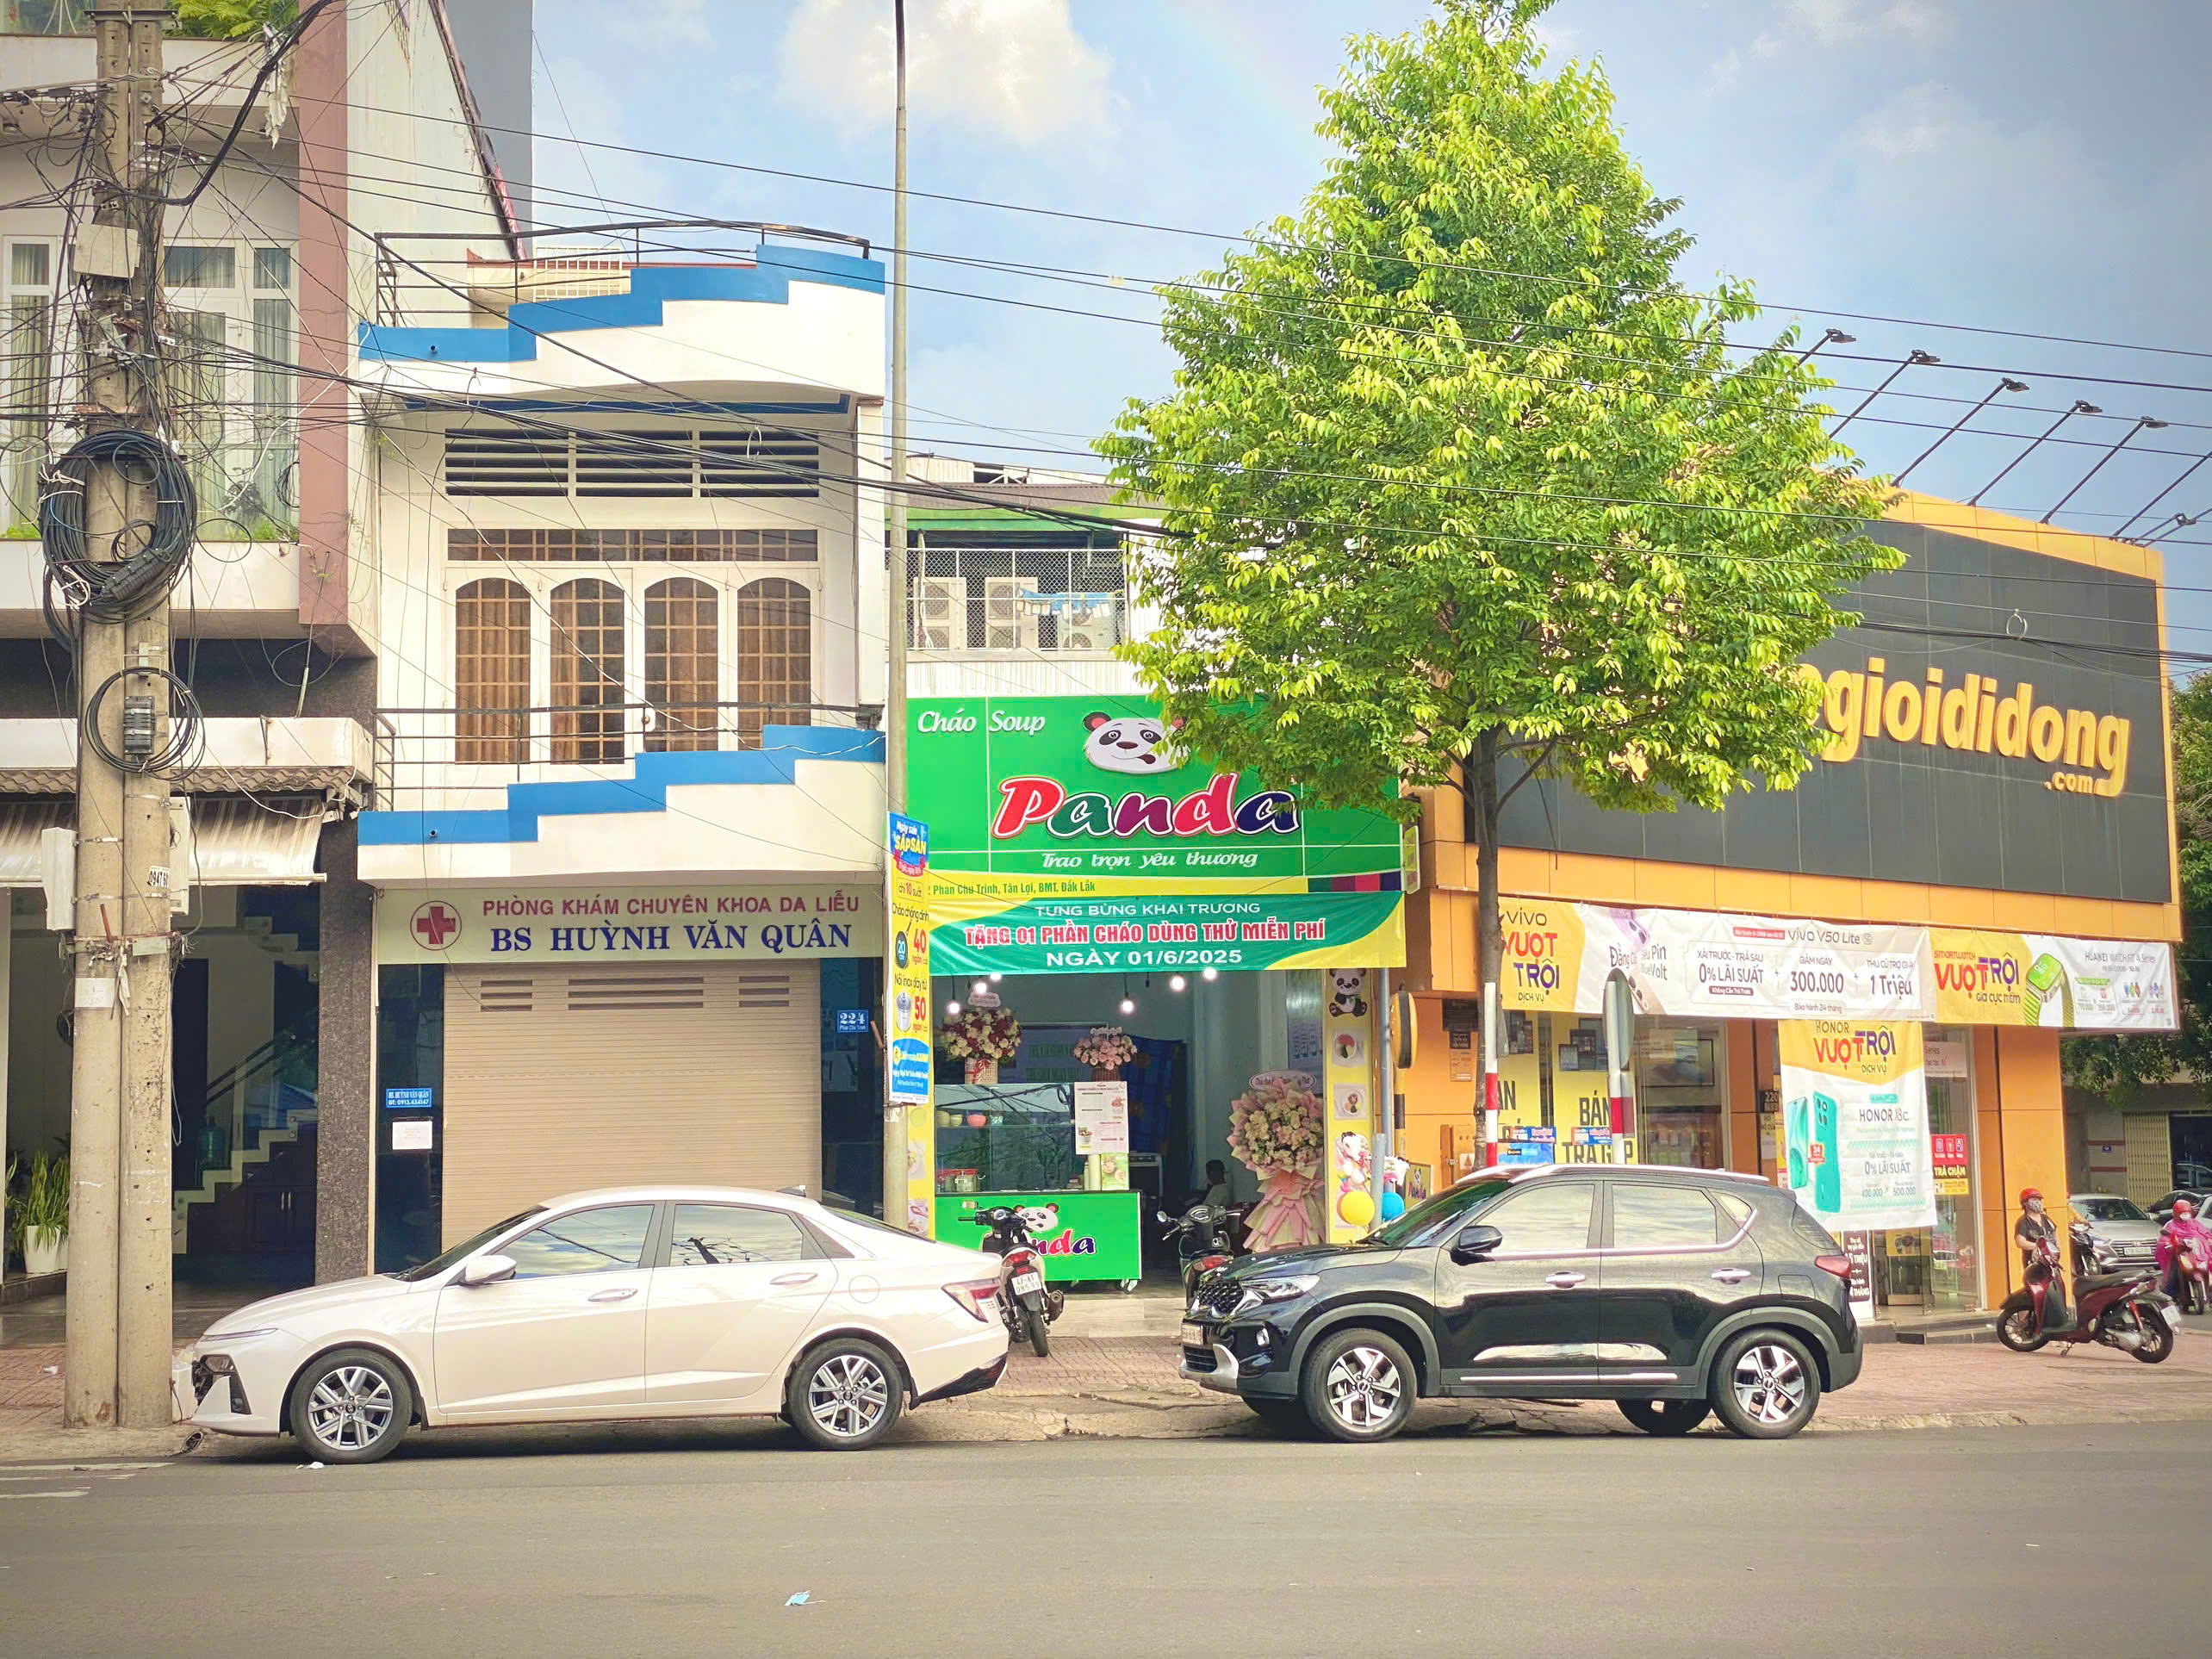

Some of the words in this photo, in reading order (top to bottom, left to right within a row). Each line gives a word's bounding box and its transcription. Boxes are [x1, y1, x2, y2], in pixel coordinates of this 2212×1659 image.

[917, 707, 977, 733] Cháo
[988, 710, 1046, 736] Soup
[1799, 657, 2129, 798] gioididong
[2043, 771, 2094, 793] .com
[991, 772, 1300, 838] Panda
[1041, 852, 1082, 867] Trao
[1090, 853, 1131, 869] trọn
[1139, 852, 1175, 868] yêu
[1185, 851, 1258, 867] thương
[933, 885, 955, 896] Phan
[1003, 882, 1018, 893] Tân
[482, 894, 554, 916] PHÒNG
[562, 893, 619, 916] KHÁM
[626, 894, 708, 915] CHUYÊN
[718, 897, 772, 914] KHOA
[780, 897, 807, 913] DA
[816, 889, 860, 913] LIỄU
[1089, 903, 1137, 916] BỪNG
[1142, 904, 1183, 916] KHAI
[1188, 903, 1260, 914] TRƯƠNG
[1507, 907, 1547, 926] vivo
[491, 927, 531, 953] BS
[550, 919, 670, 953] HUỲNH
[683, 919, 748, 950] VĂN
[761, 916, 853, 953] QUÂN
[913, 929, 927, 954] 40
[964, 923, 1011, 949] TẶNG
[1016, 926, 1036, 945] 01
[1041, 918, 1089, 945] PHẦN
[1094, 920, 1143, 943] CHÁO
[1147, 921, 1197, 942] DÙNG
[1202, 918, 1237, 941] THỬ
[1242, 916, 1289, 941] MIỄN
[1294, 917, 1326, 941] PHÍ
[1788, 927, 1815, 942] vivo
[1817, 930, 1840, 943] V50
[1842, 930, 1861, 944] Lite
[1047, 948, 1122, 966] NGÀY
[1128, 949, 1242, 966] 01/6/2025
[1651, 944, 1667, 960] Pin
[1513, 958, 1560, 996] TRỘI
[1699, 963, 1716, 984] 0%
[1790, 971, 1844, 994] 300.000
[1978, 952, 2020, 991] TRỘI
[840, 1012, 866, 1025] 224
[914, 996, 926, 1021] 50
[1816, 1021, 1849, 1034] HONOR
[1855, 1025, 1896, 1062] TRỘI
[1859, 1109, 1893, 1122] HONOR
[1031, 1229, 1097, 1255] nda
